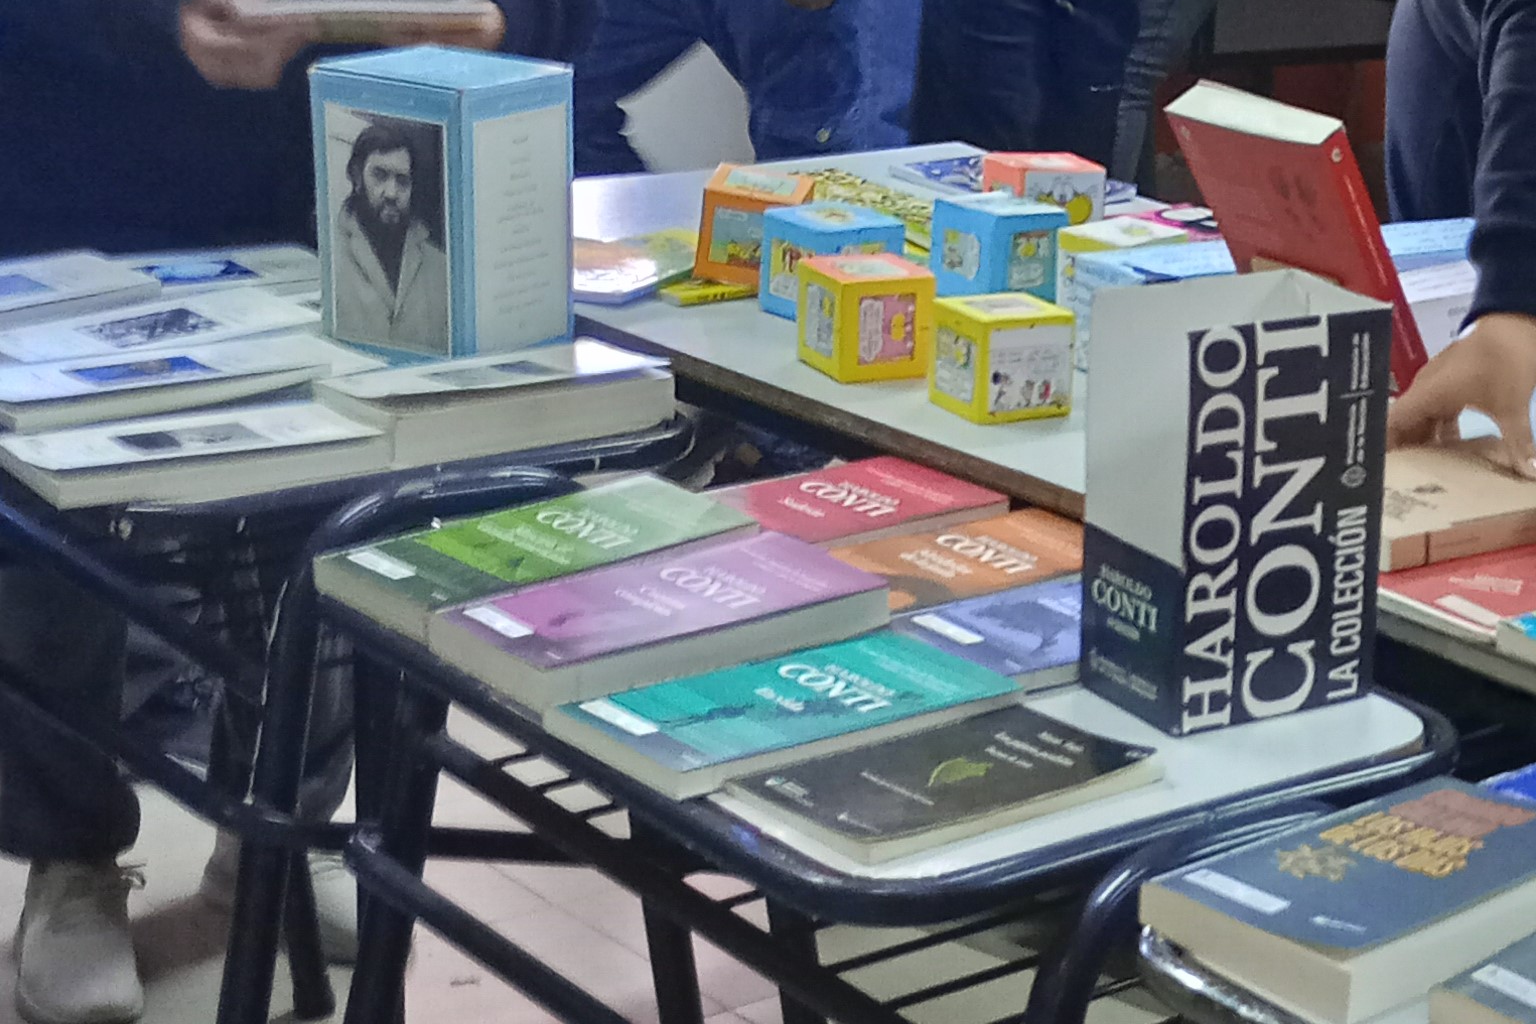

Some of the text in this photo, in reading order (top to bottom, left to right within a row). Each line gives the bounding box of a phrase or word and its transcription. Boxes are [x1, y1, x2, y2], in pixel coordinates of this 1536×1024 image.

[799, 480, 900, 518] CONTI
[1240, 313, 1330, 720] CONTI
[535, 508, 636, 551] CONTI
[1182, 324, 1247, 734] HAROLDO
[934, 533, 1038, 575] CONTI
[659, 566, 762, 610] CONTI
[1330, 504, 1367, 657] COLECCIÓN
[1090, 578, 1159, 634] CONTI
[776, 662, 893, 713] CONTI
[1326, 658, 1360, 699] LA
